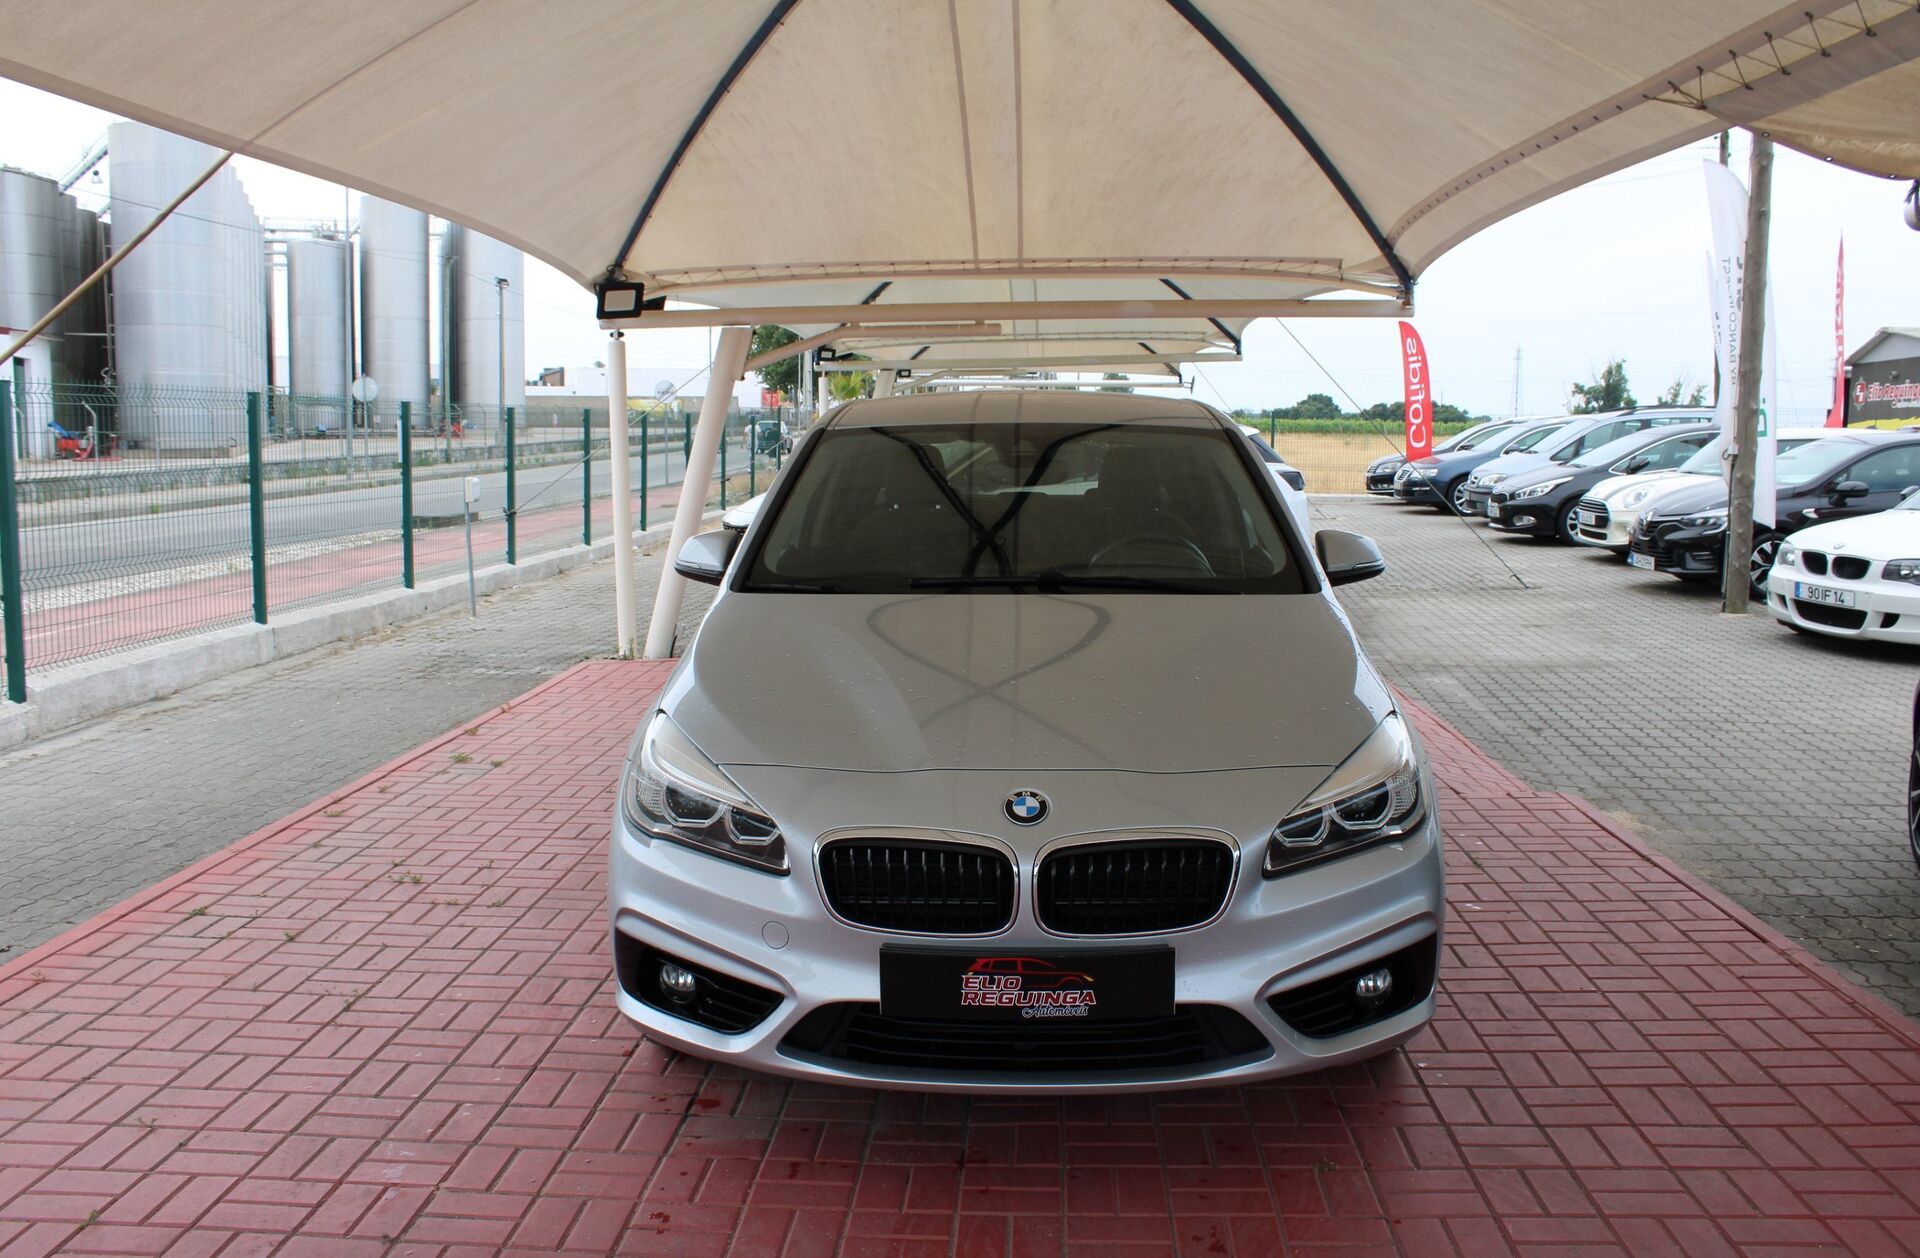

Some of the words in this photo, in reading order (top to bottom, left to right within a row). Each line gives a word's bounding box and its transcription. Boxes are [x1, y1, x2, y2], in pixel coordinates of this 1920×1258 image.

[1867, 382, 1883, 401] Elio
[1883, 379, 1920, 402] Reguing
[1009, 791, 1045, 802] BMW
[961, 975, 1022, 991] ELIO
[961, 990, 1096, 1006] REGUINGA
